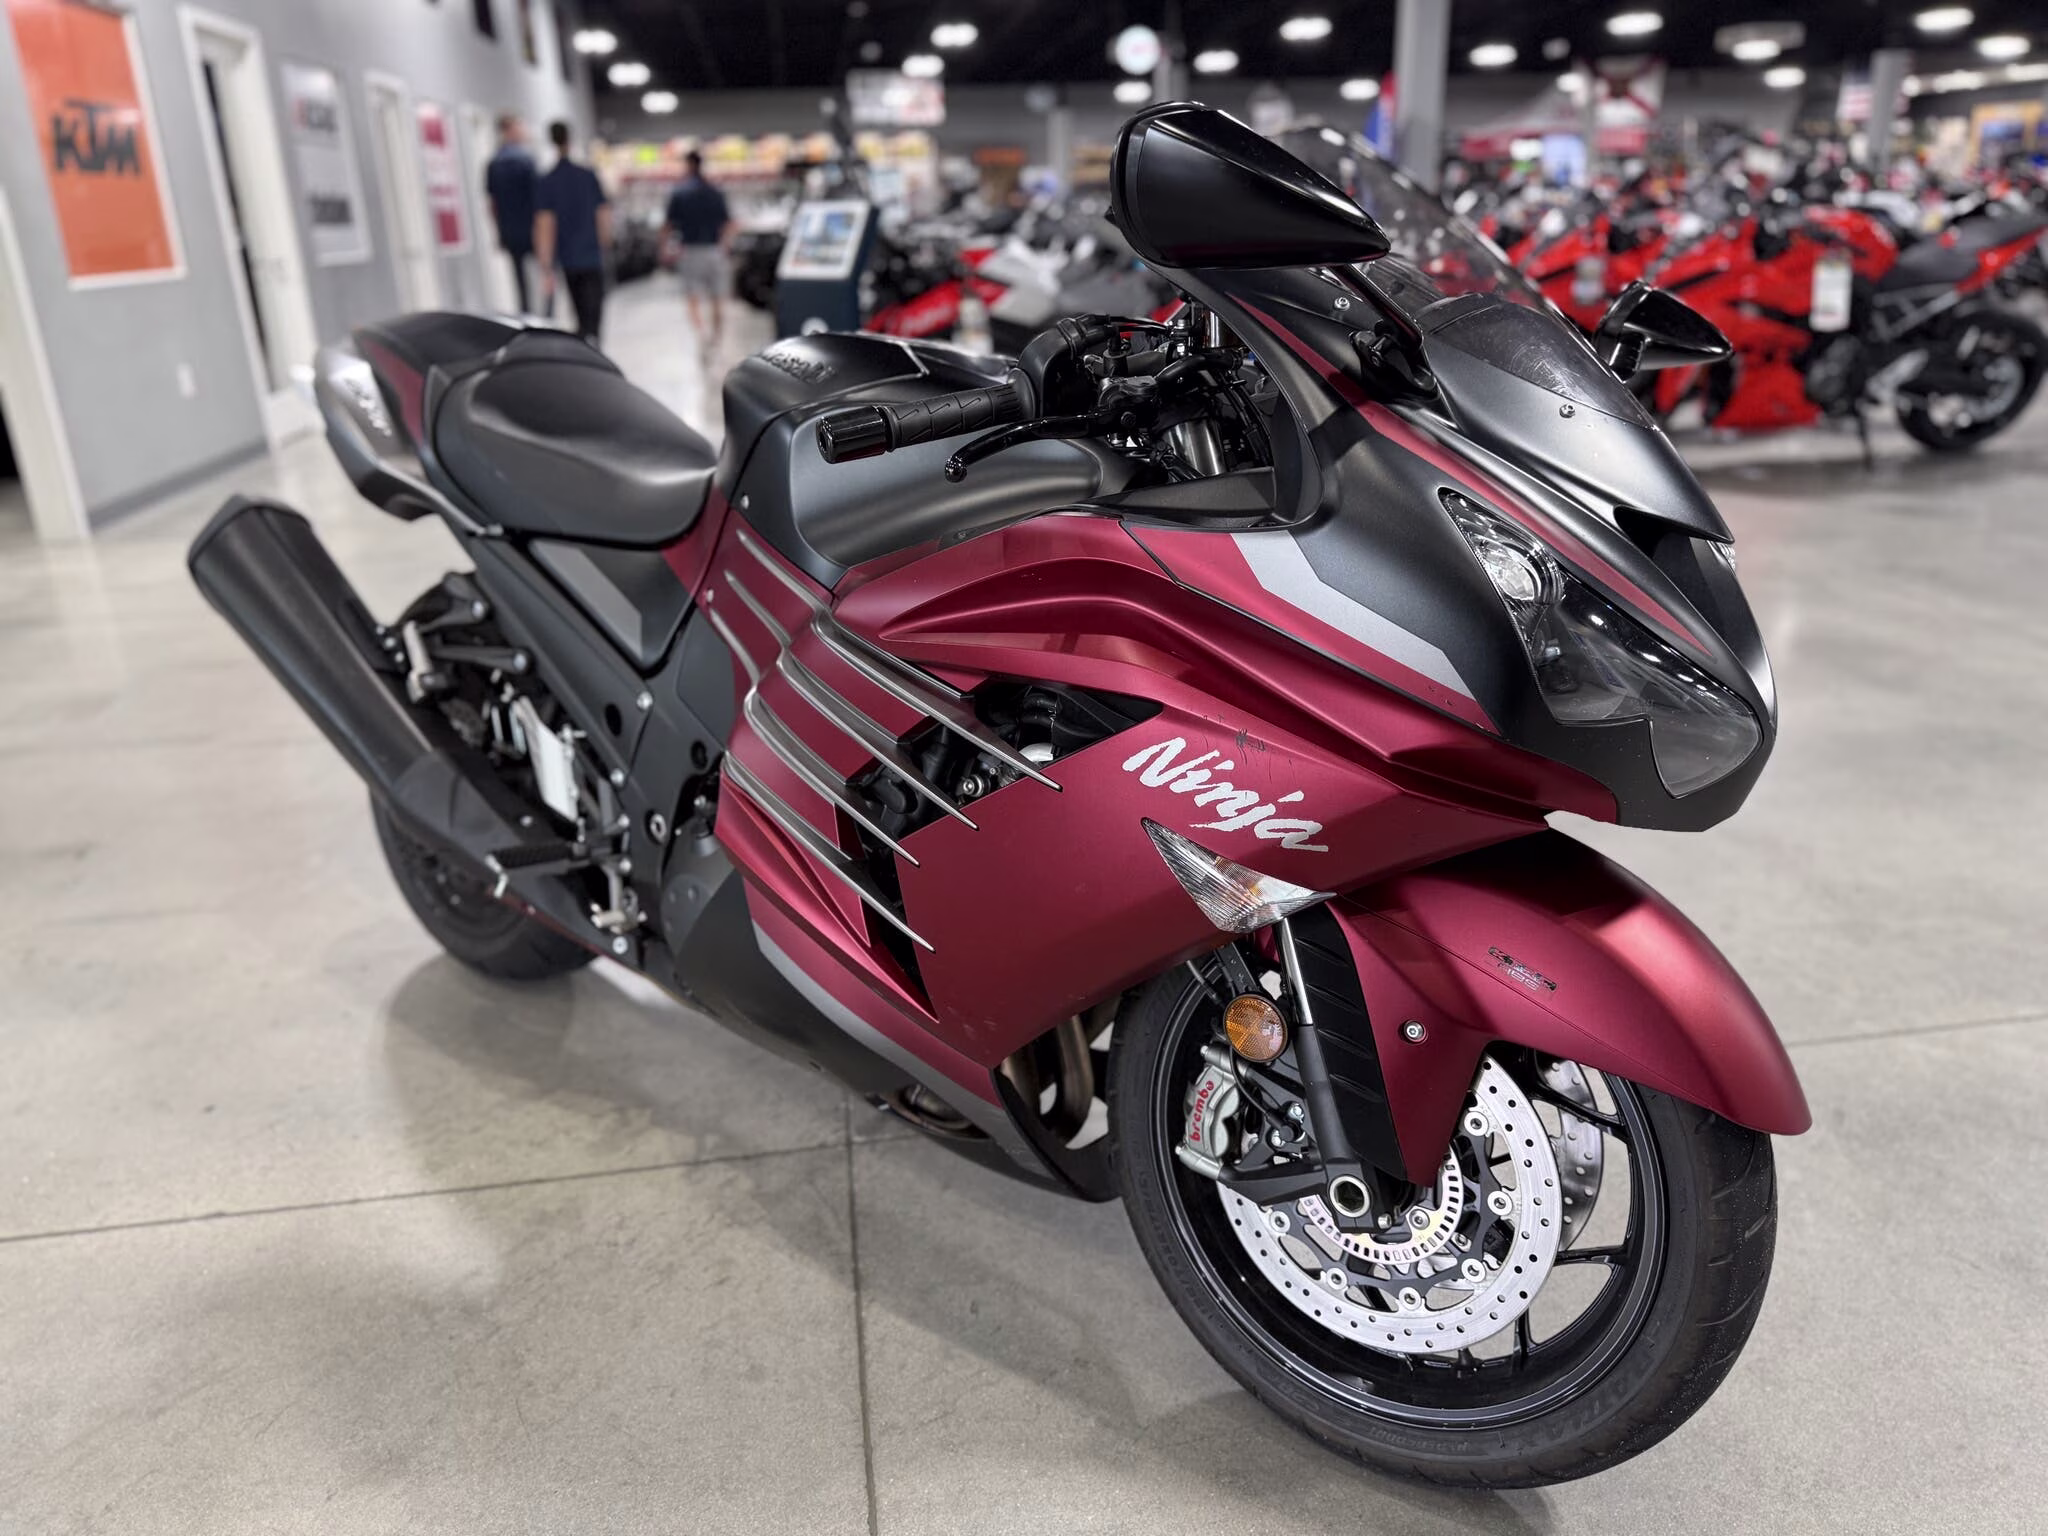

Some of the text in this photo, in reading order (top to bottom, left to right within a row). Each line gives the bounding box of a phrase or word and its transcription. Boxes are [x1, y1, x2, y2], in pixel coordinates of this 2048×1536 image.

[52, 98, 141, 176] KTM
[1122, 736, 1329, 852] Ninja
[1189, 1080, 1214, 1142] brembo
